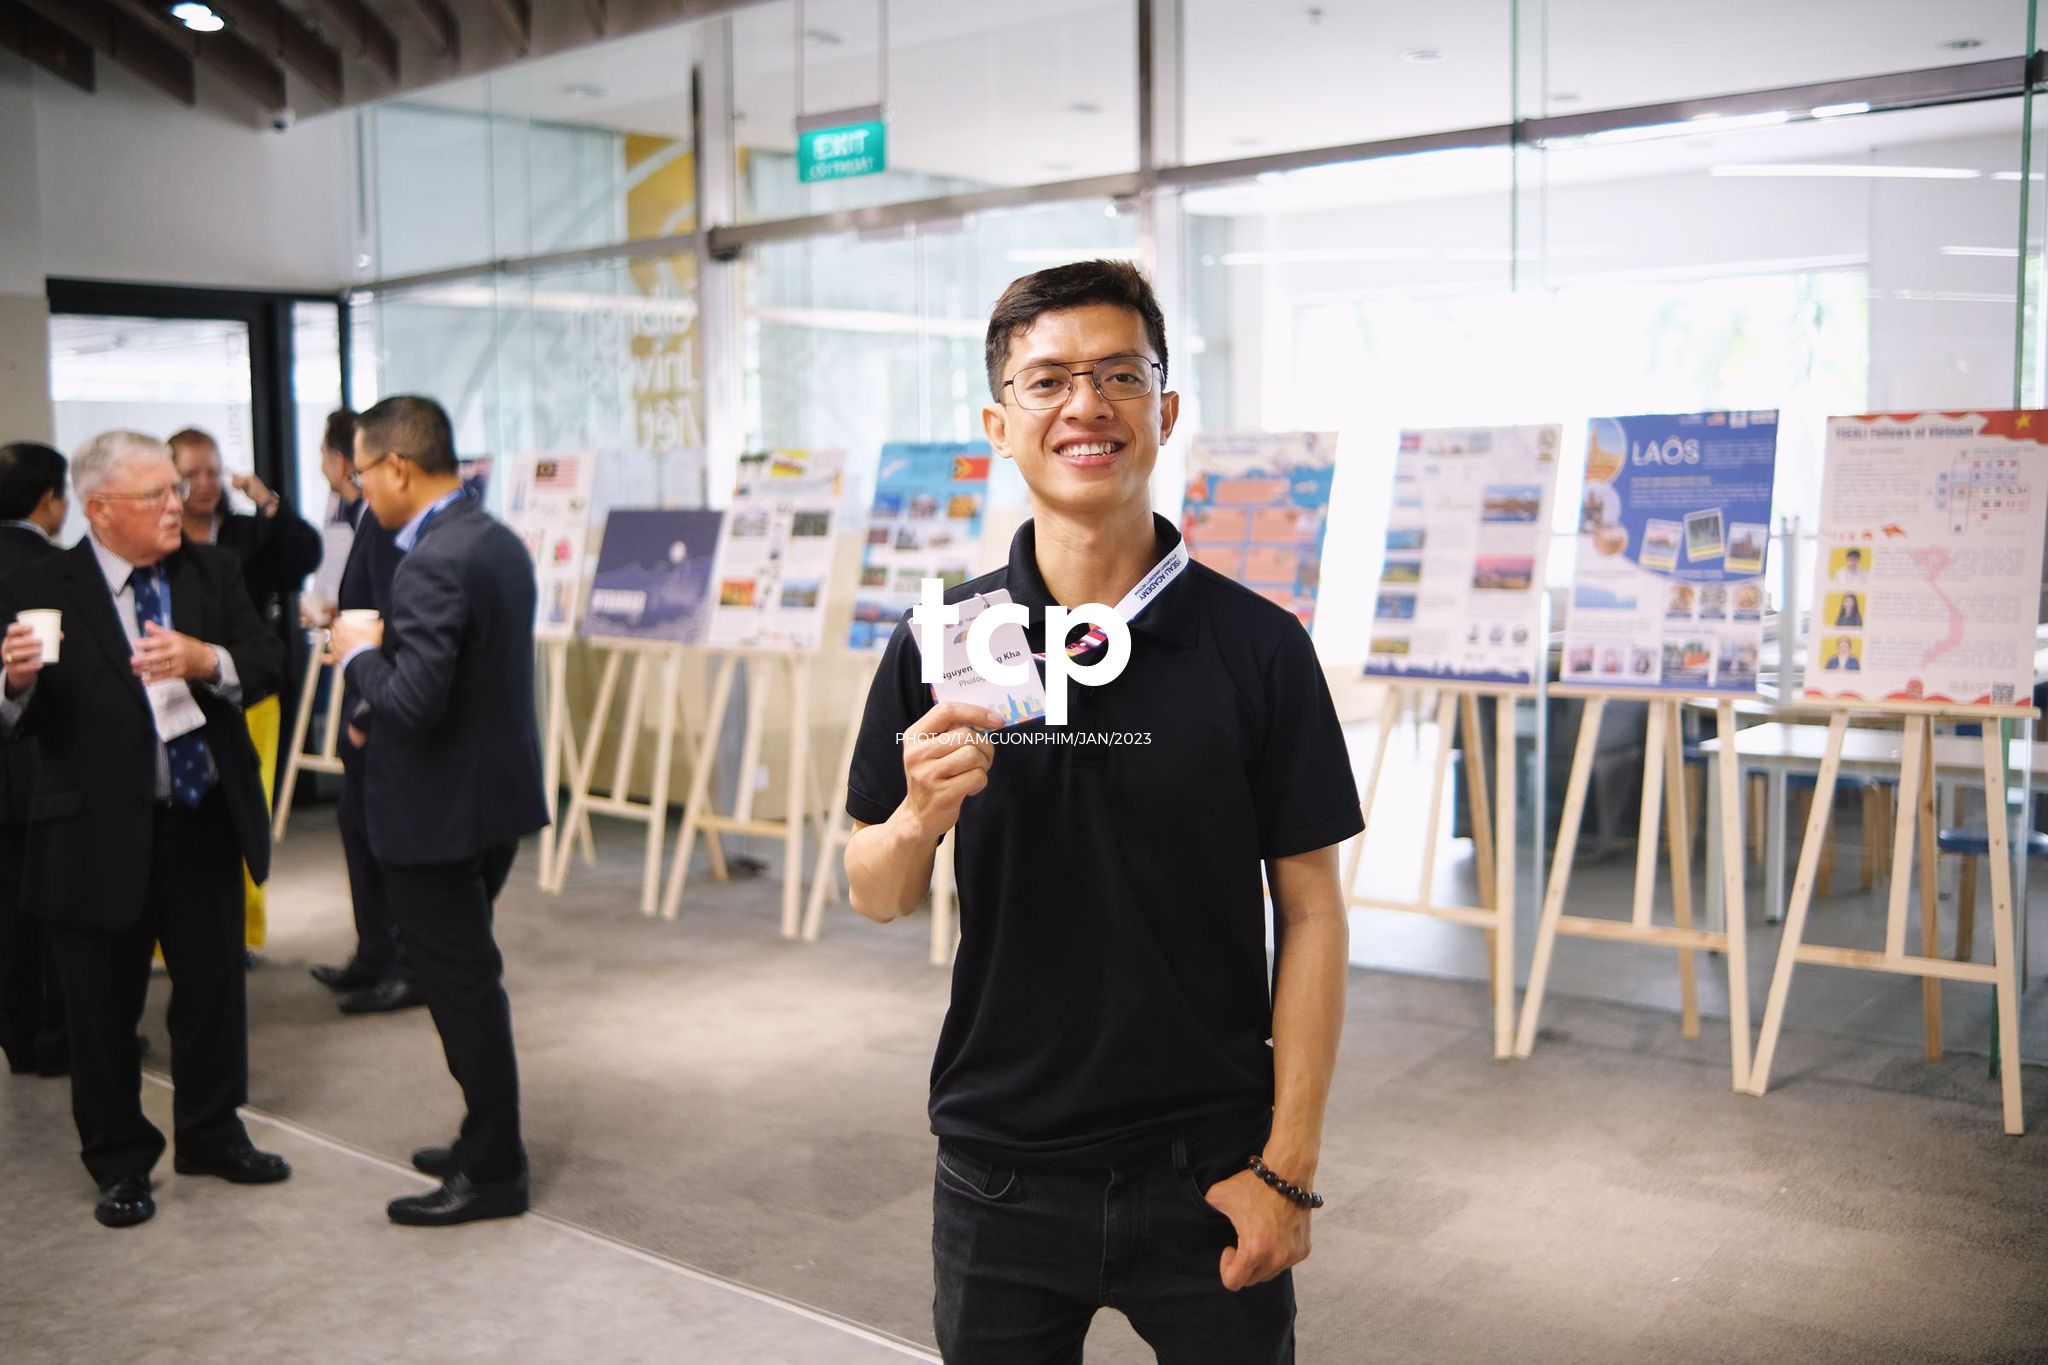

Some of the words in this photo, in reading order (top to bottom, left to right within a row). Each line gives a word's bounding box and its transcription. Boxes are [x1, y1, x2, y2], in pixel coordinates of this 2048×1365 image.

[812, 130, 870, 161] EXIT
[1139, 572, 1166, 601] ACADEMY
[1003, 650, 1021, 661] Kha
